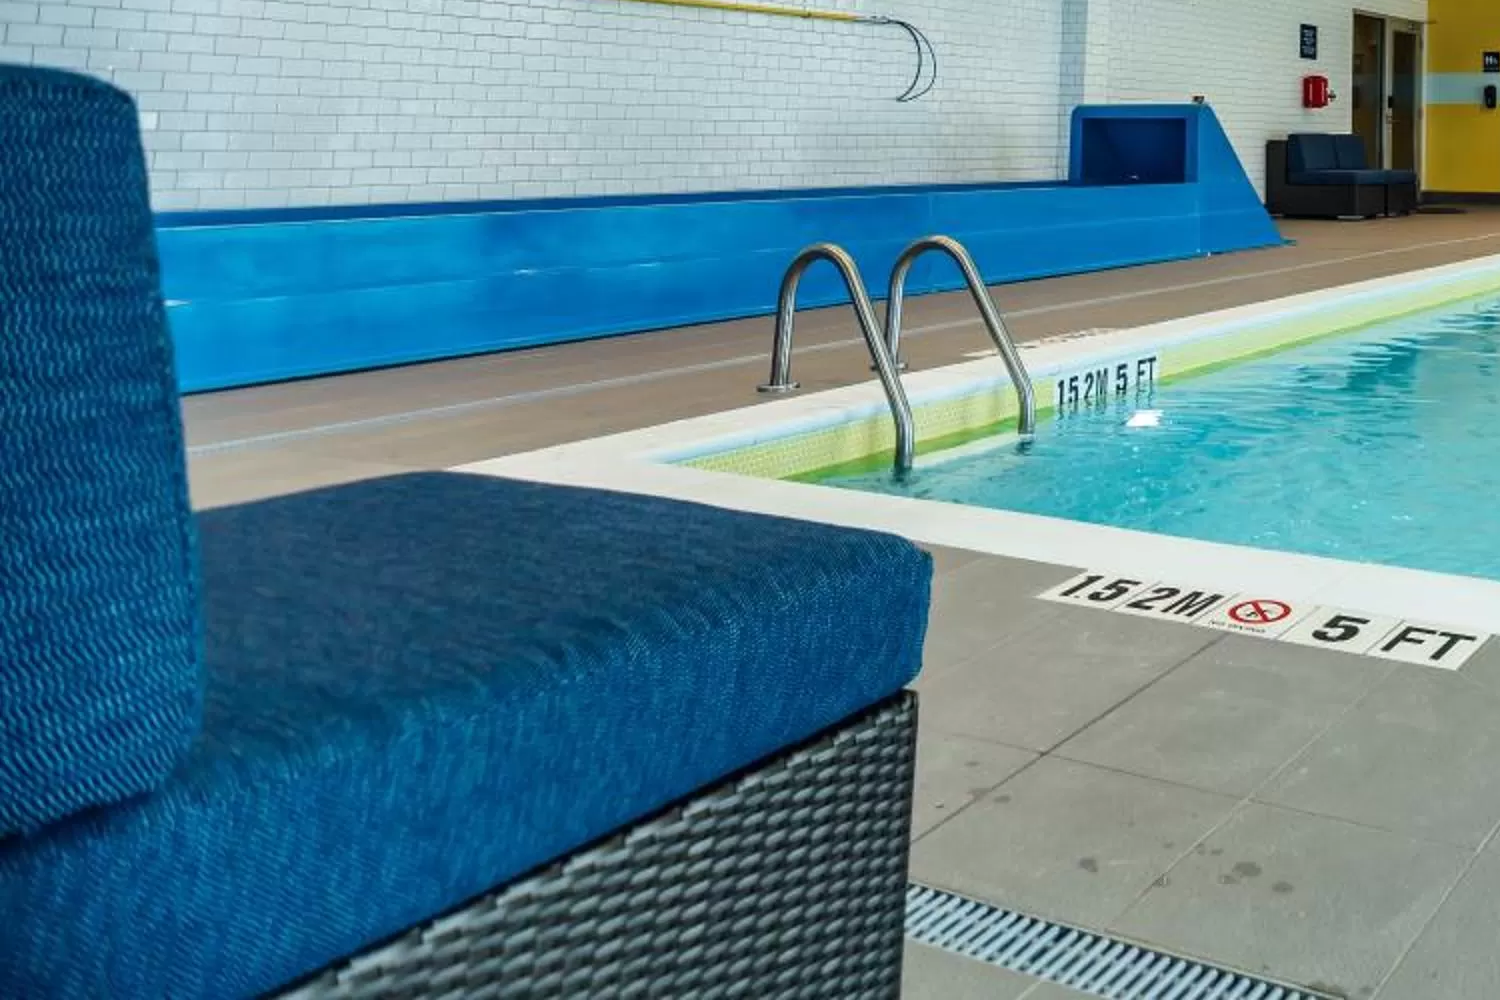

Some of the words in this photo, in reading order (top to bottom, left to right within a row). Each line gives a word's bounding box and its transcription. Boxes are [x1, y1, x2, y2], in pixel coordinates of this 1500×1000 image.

[1115, 362, 1129, 392] 5
[1312, 614, 1371, 643] 5
[1380, 625, 1477, 661] FT
